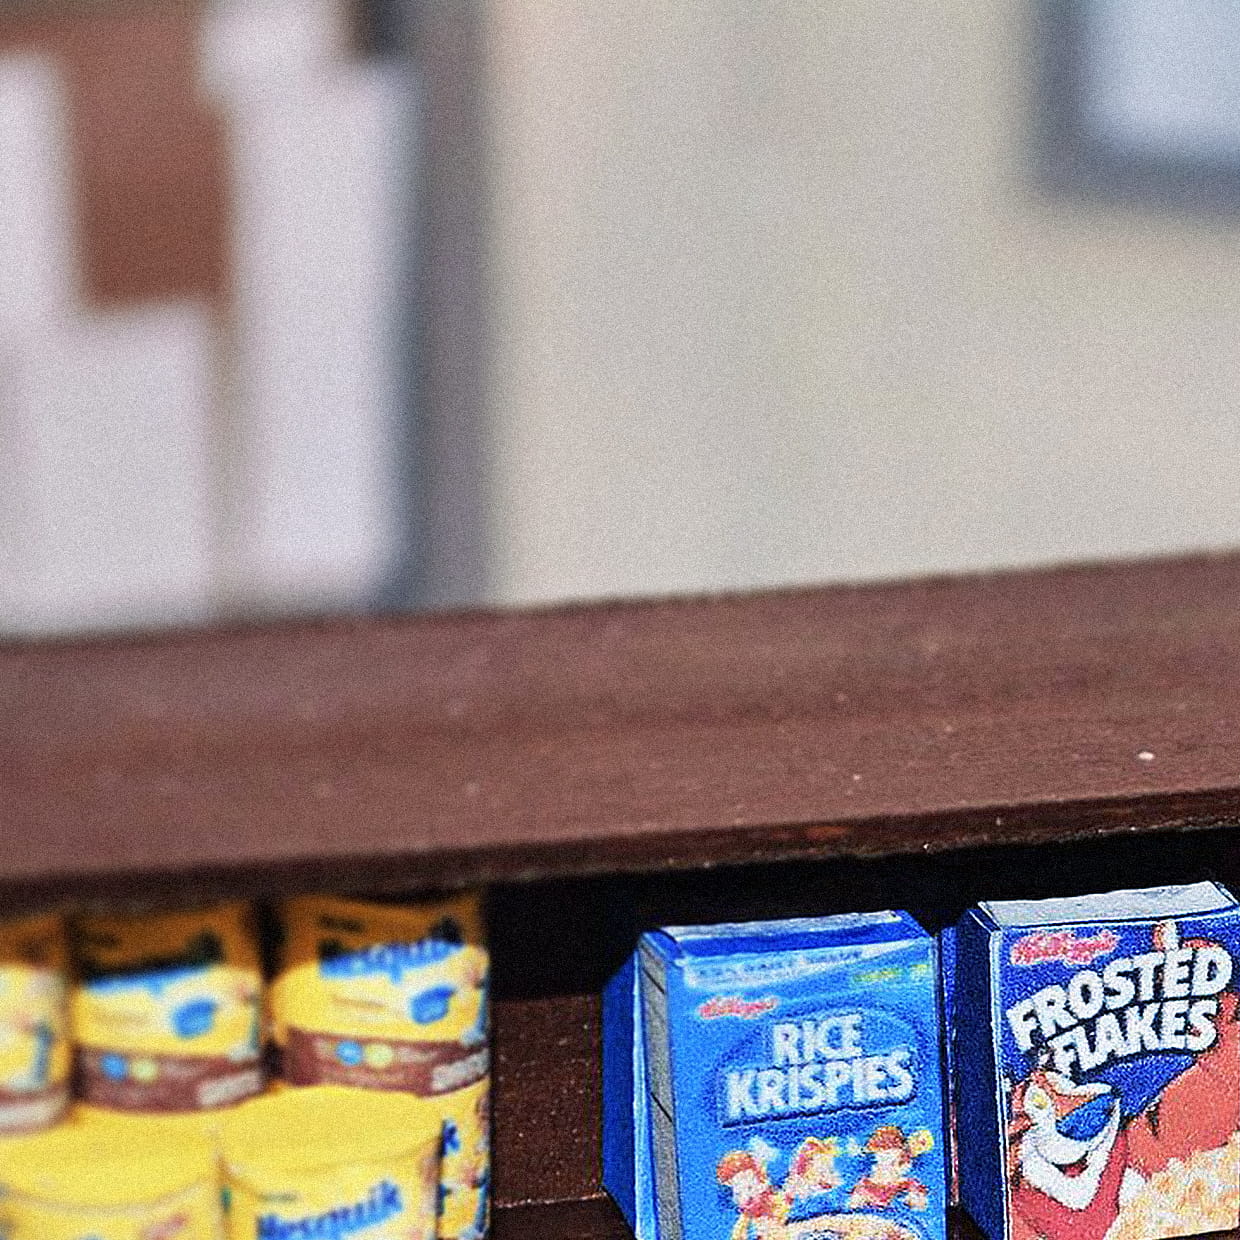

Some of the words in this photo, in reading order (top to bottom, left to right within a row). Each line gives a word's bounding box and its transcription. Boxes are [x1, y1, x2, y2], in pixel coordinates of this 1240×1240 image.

[1005, 946, 1233, 1051] FROSTED
[772, 1013, 863, 1066] RICE
[1047, 1000, 1214, 1078] FLAKES
[725, 1046, 914, 1120] KRISPIES
